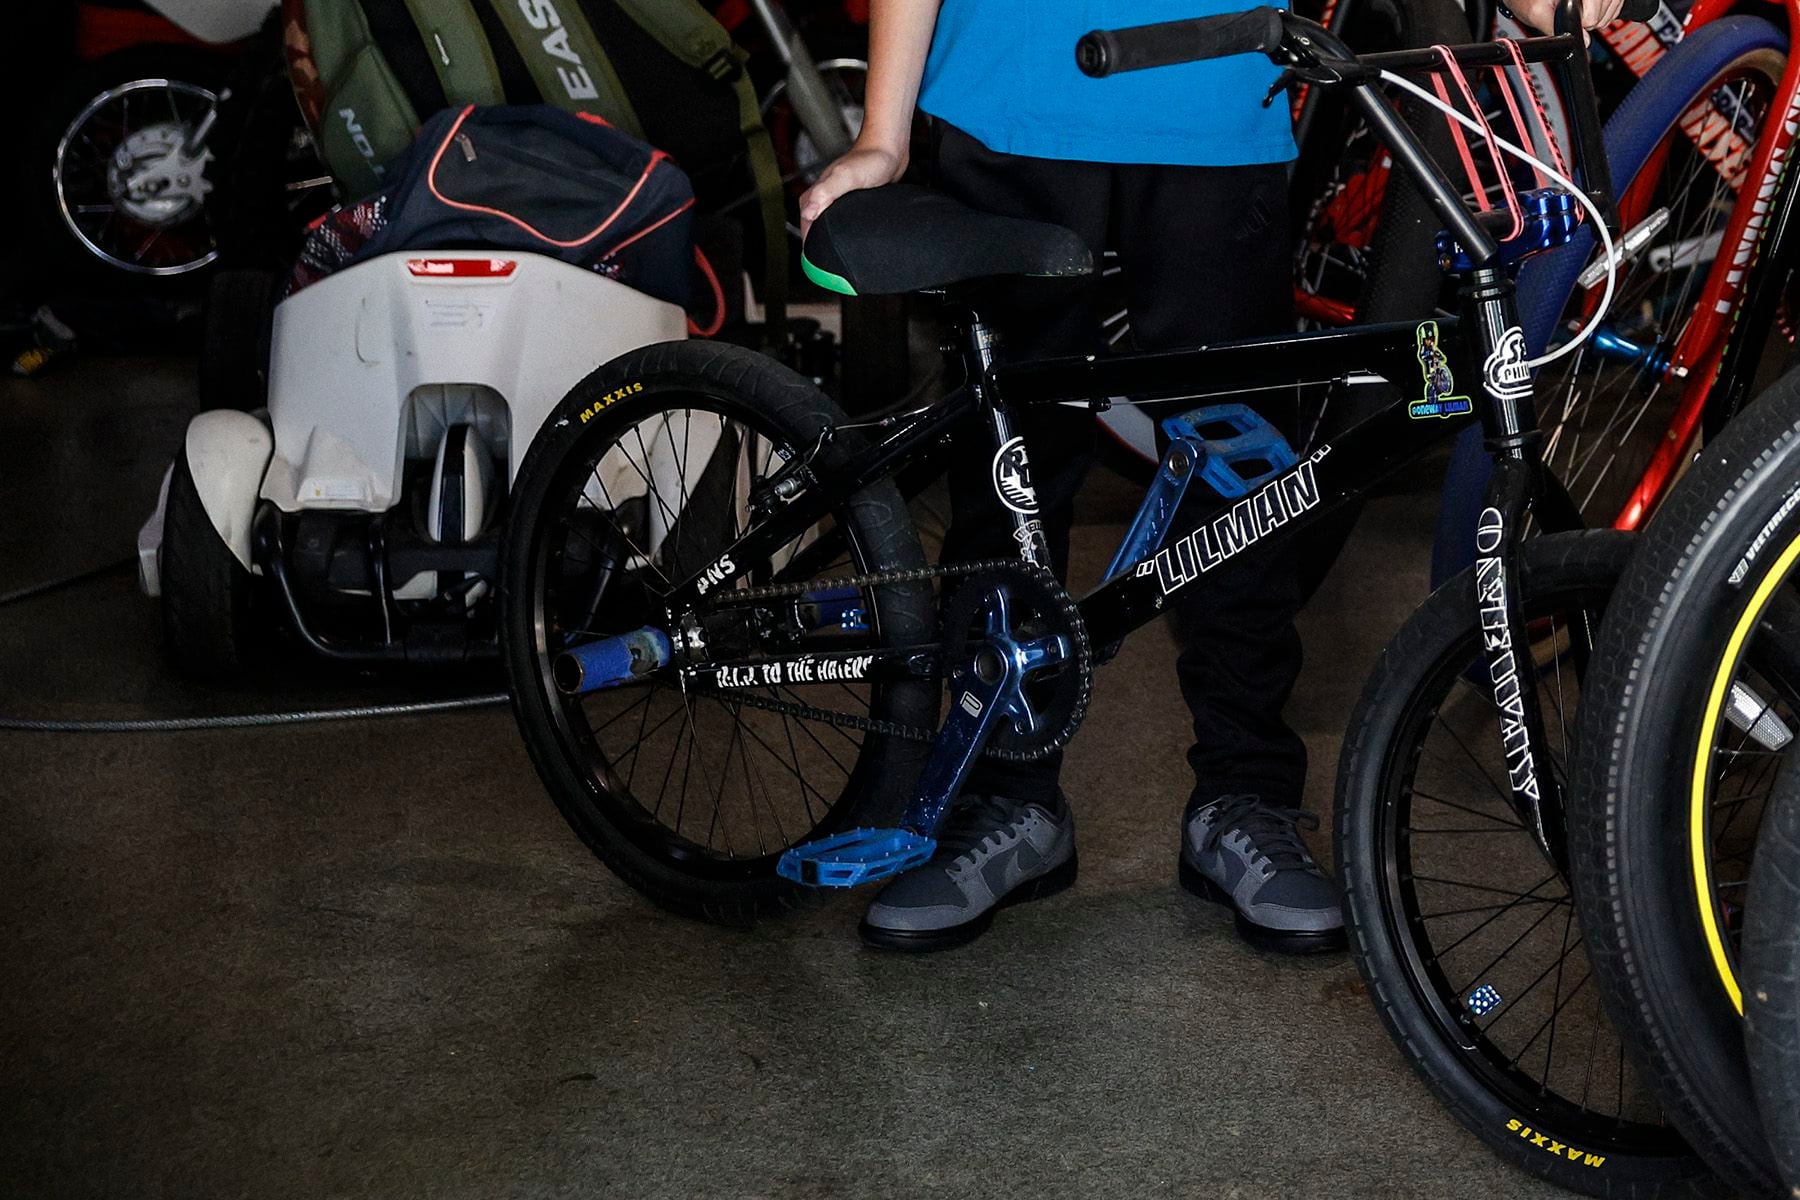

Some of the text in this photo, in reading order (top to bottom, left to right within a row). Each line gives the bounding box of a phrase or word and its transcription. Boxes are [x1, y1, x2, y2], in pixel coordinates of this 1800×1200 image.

[579, 382, 643, 424] MAXXIS
[1477, 507, 1540, 800] ONEWAY
[1506, 1119, 1606, 1168] MAXXIS
